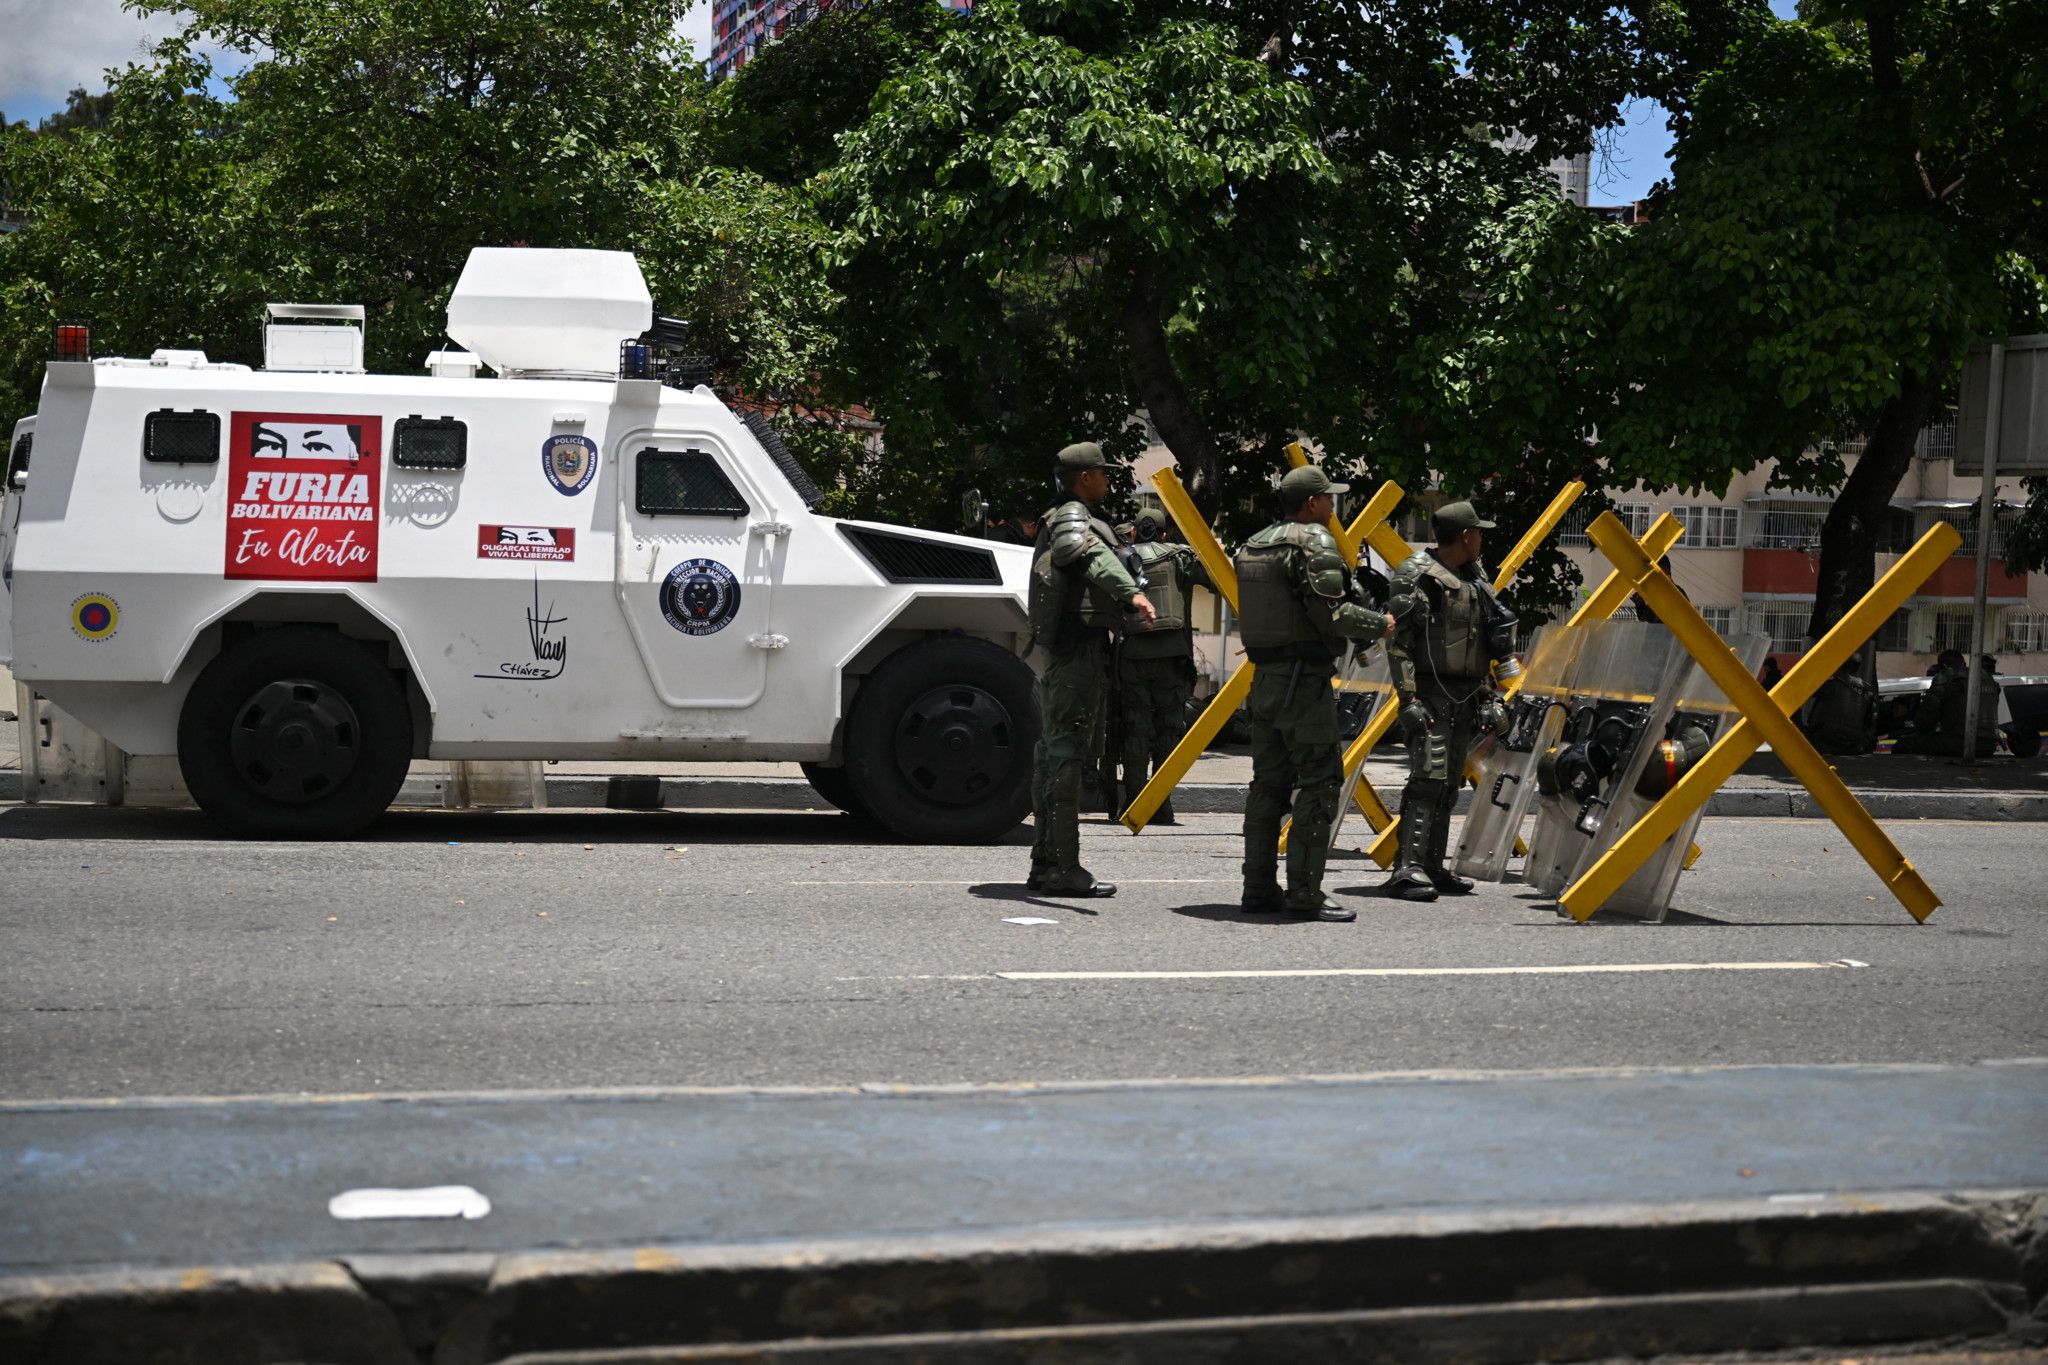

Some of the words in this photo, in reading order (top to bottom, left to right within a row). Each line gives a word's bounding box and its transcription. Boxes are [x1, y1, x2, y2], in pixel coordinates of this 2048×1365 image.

[554, 437, 585, 446] POLICÍA
[545, 455, 560, 487] NACIONAL
[577, 451, 596, 490] BOLIVARIANA
[240, 471, 369, 504] FURIA
[231, 503, 373, 521] BOLIVARIANA
[235, 529, 272, 565] En
[279, 526, 370, 567] Alerta
[481, 544, 530, 553] OLIGARCAS
[531, 546, 571, 554] TEMBLAD
[523, 552, 565, 560] LIBERTAD
[671, 561, 692, 577] CUERPO
[500, 662, 551, 678] CHÁVEZ
